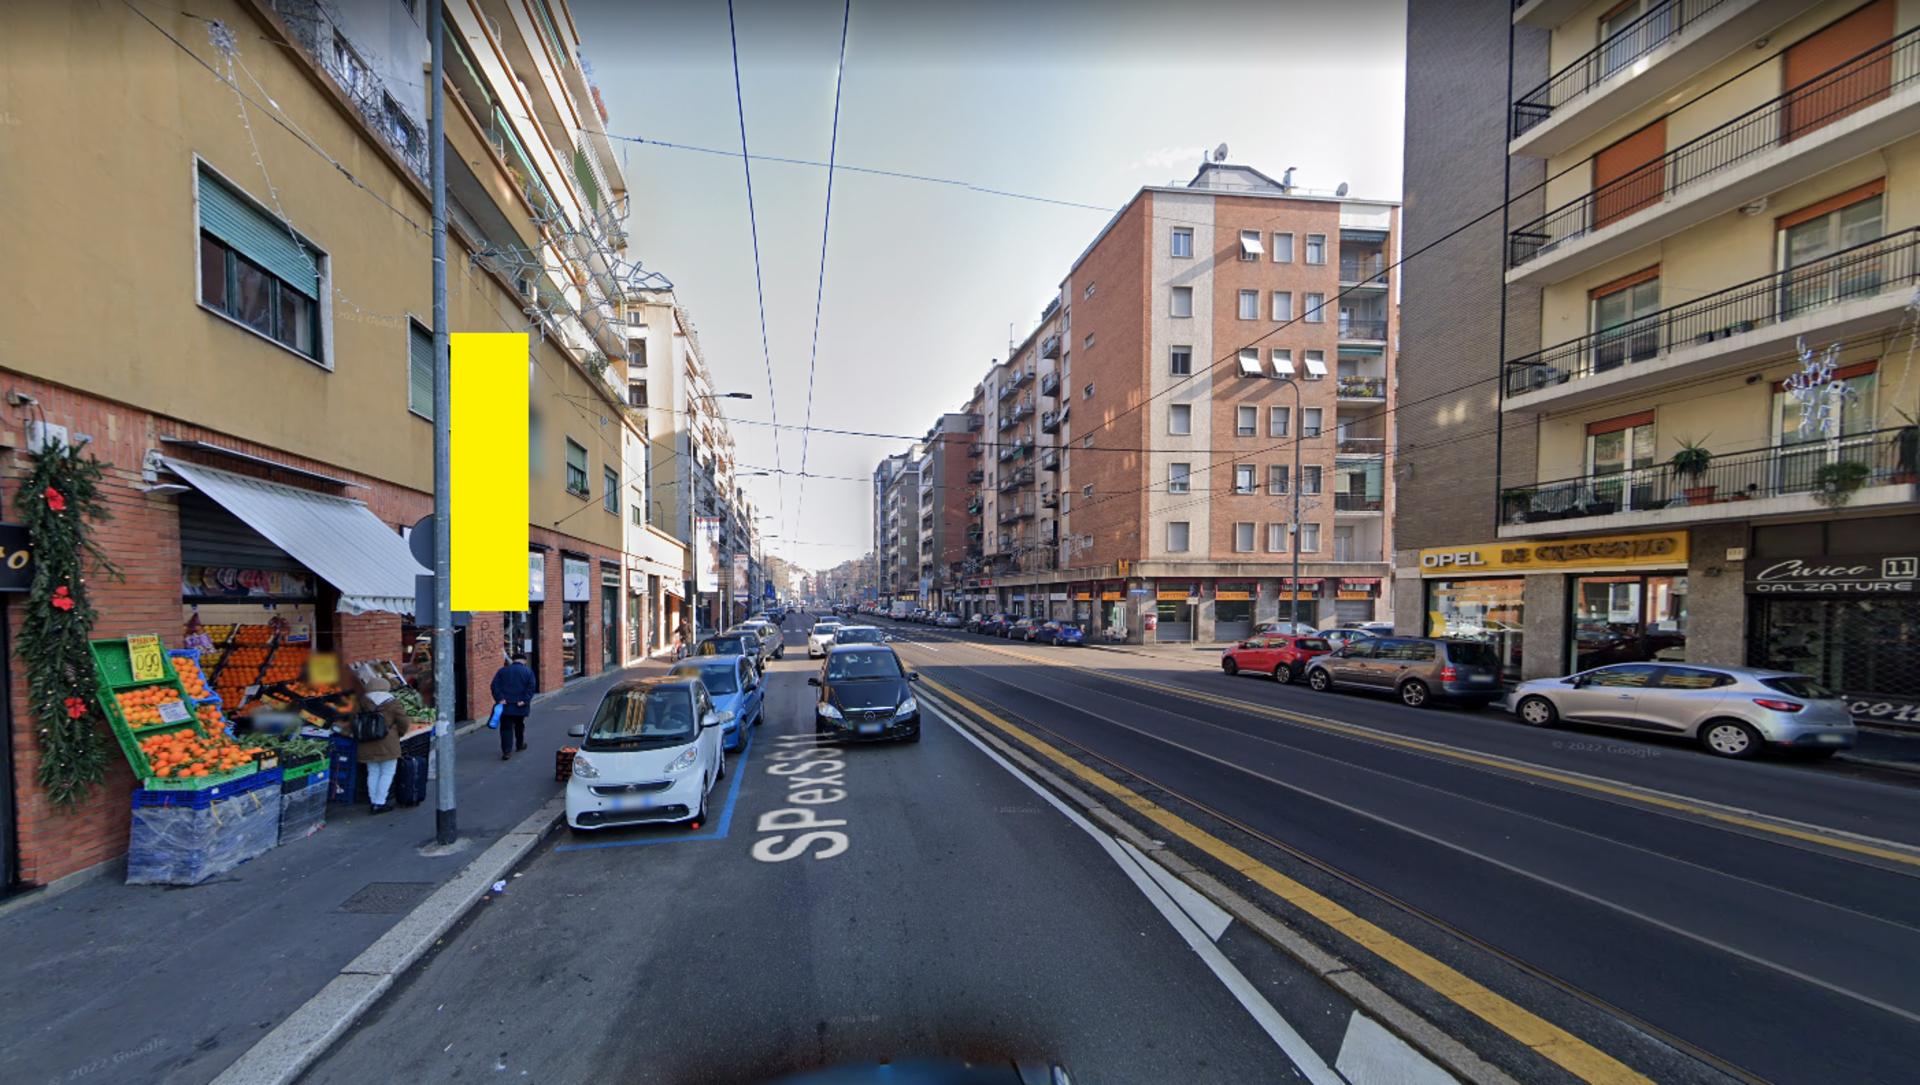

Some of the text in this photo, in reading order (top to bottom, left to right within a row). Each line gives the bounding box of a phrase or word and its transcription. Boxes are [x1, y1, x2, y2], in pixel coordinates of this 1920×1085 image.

[1423, 551, 1485, 568] OPEL
[1757, 560, 1913, 581] Civico 11
[1756, 581, 1912, 592] CALZATURE
